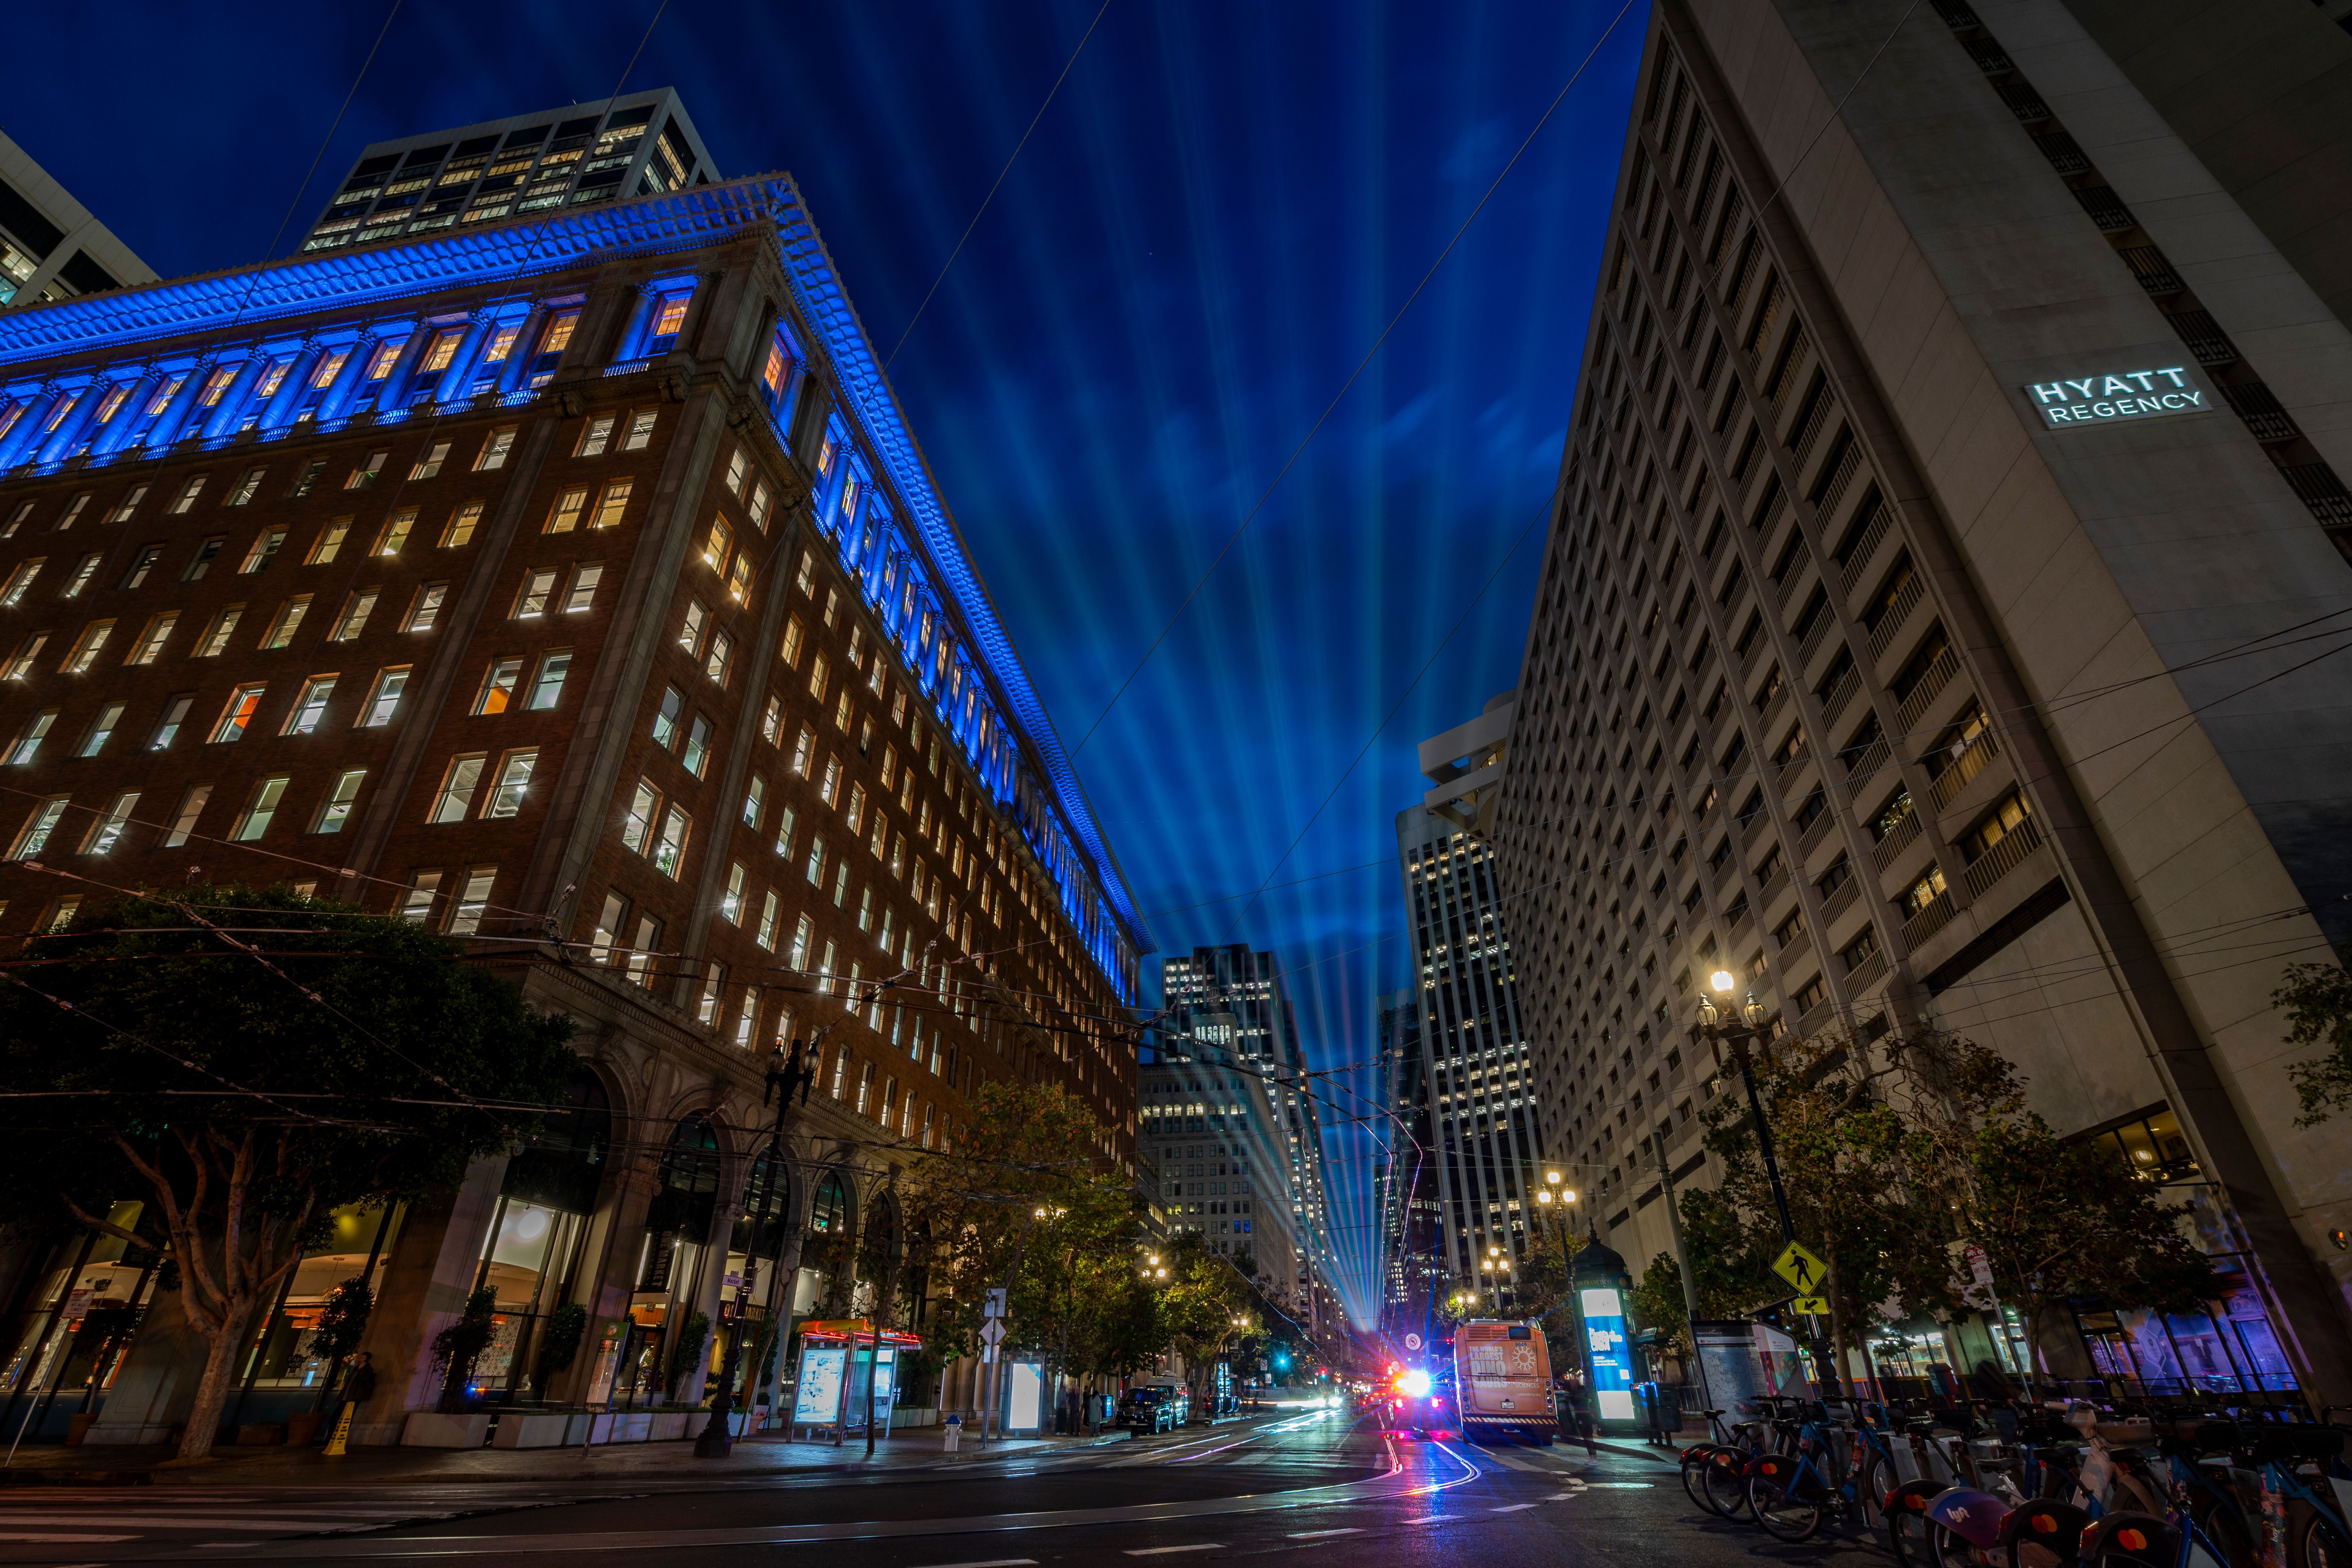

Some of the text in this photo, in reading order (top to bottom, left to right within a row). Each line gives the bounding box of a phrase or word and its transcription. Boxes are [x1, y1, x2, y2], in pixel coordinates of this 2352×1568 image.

[2033, 367, 2184, 404] HYATT
[2048, 391, 2200, 424] REGENCY
[660, 1230, 673, 1248] ONE
[652, 1250, 669, 1287] MARKET
[1470, 1352, 1503, 1361] LARGEST
[1471, 1360, 1506, 1376] DINO
[1472, 1376, 1508, 1388] SAURS
[1946, 1507, 1971, 1523] lyft
[2270, 1527, 2281, 1543] bay
